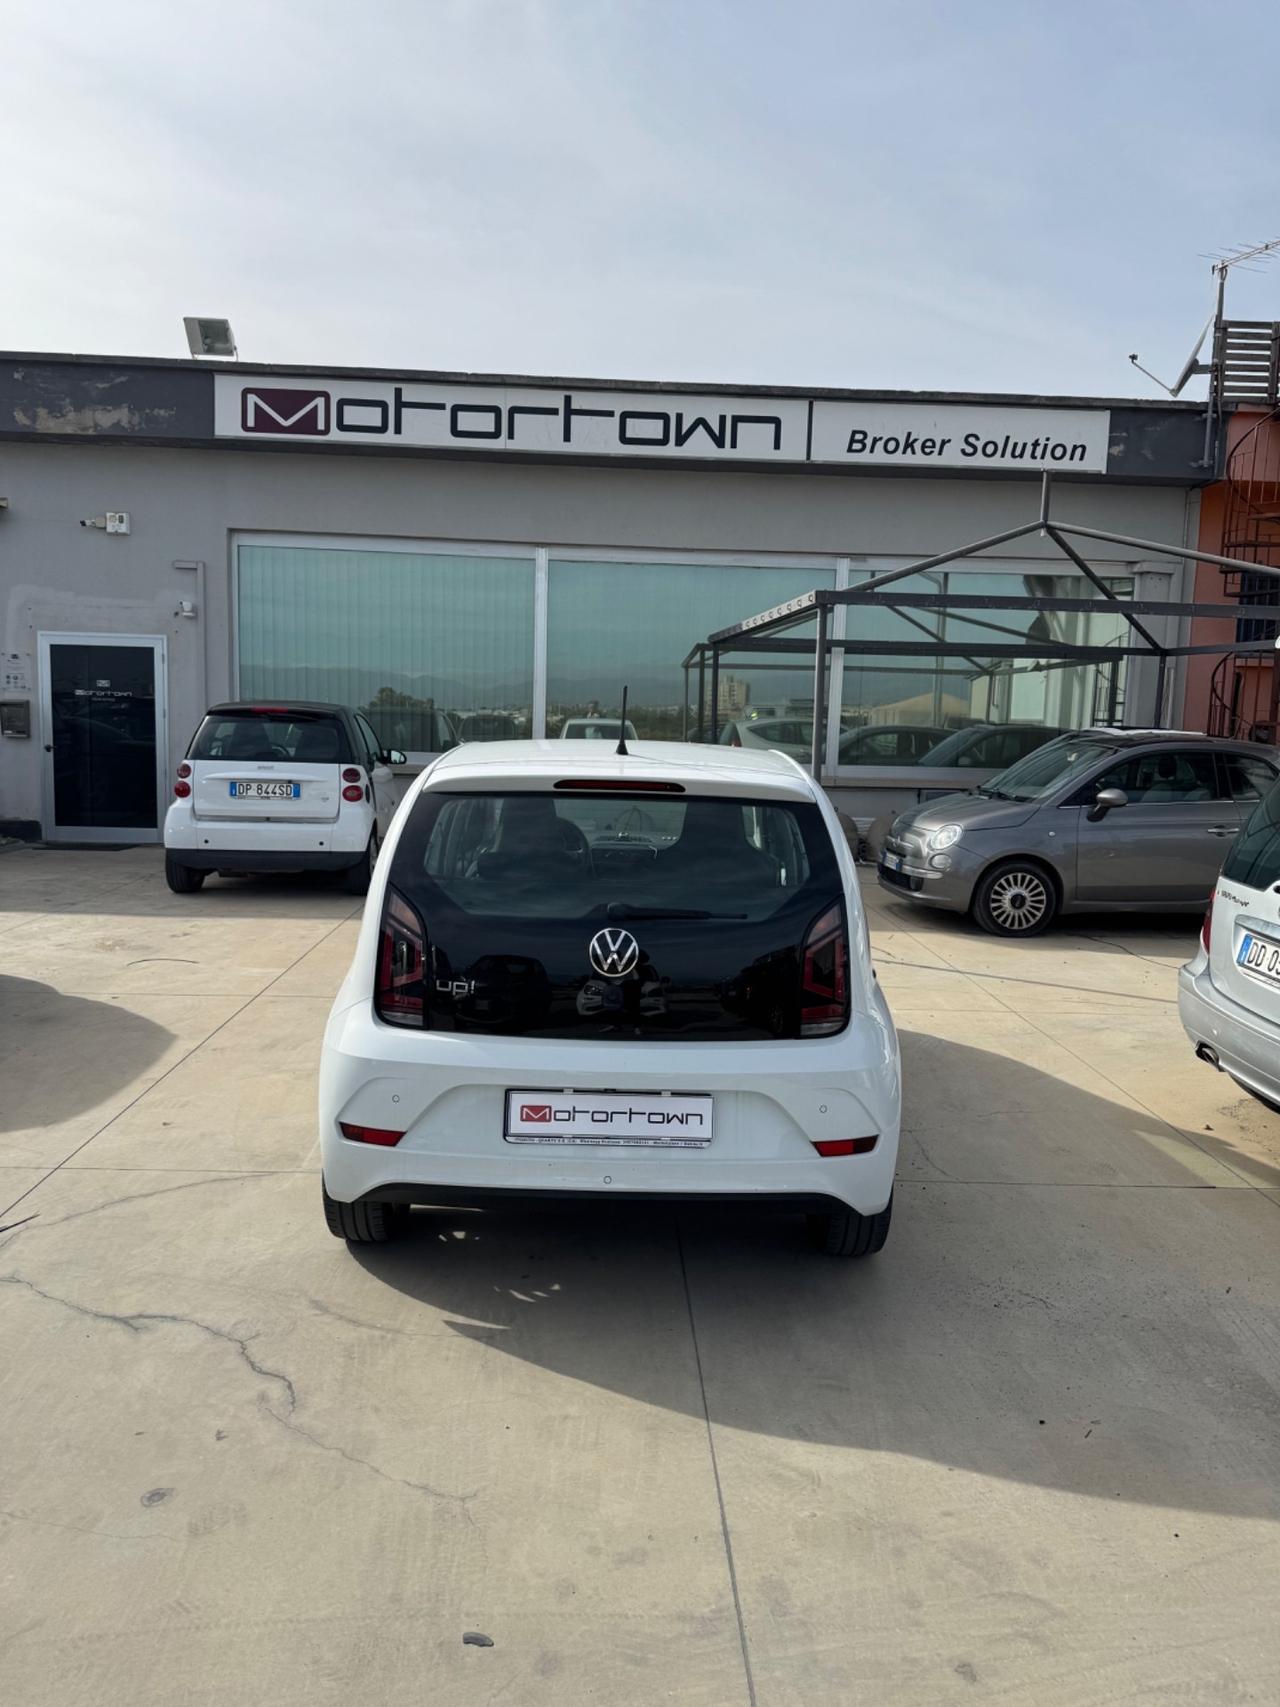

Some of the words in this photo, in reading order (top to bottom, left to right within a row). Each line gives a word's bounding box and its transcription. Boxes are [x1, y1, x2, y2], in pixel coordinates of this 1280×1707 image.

[242, 387, 782, 450] Motortown
[846, 429, 951, 456] Broker
[960, 433, 1087, 461] Solution
[238, 784, 252, 795] DP
[256, 785, 293, 796] 844SD
[1247, 942, 1267, 967] DD
[520, 1105, 704, 1126] Motortown
